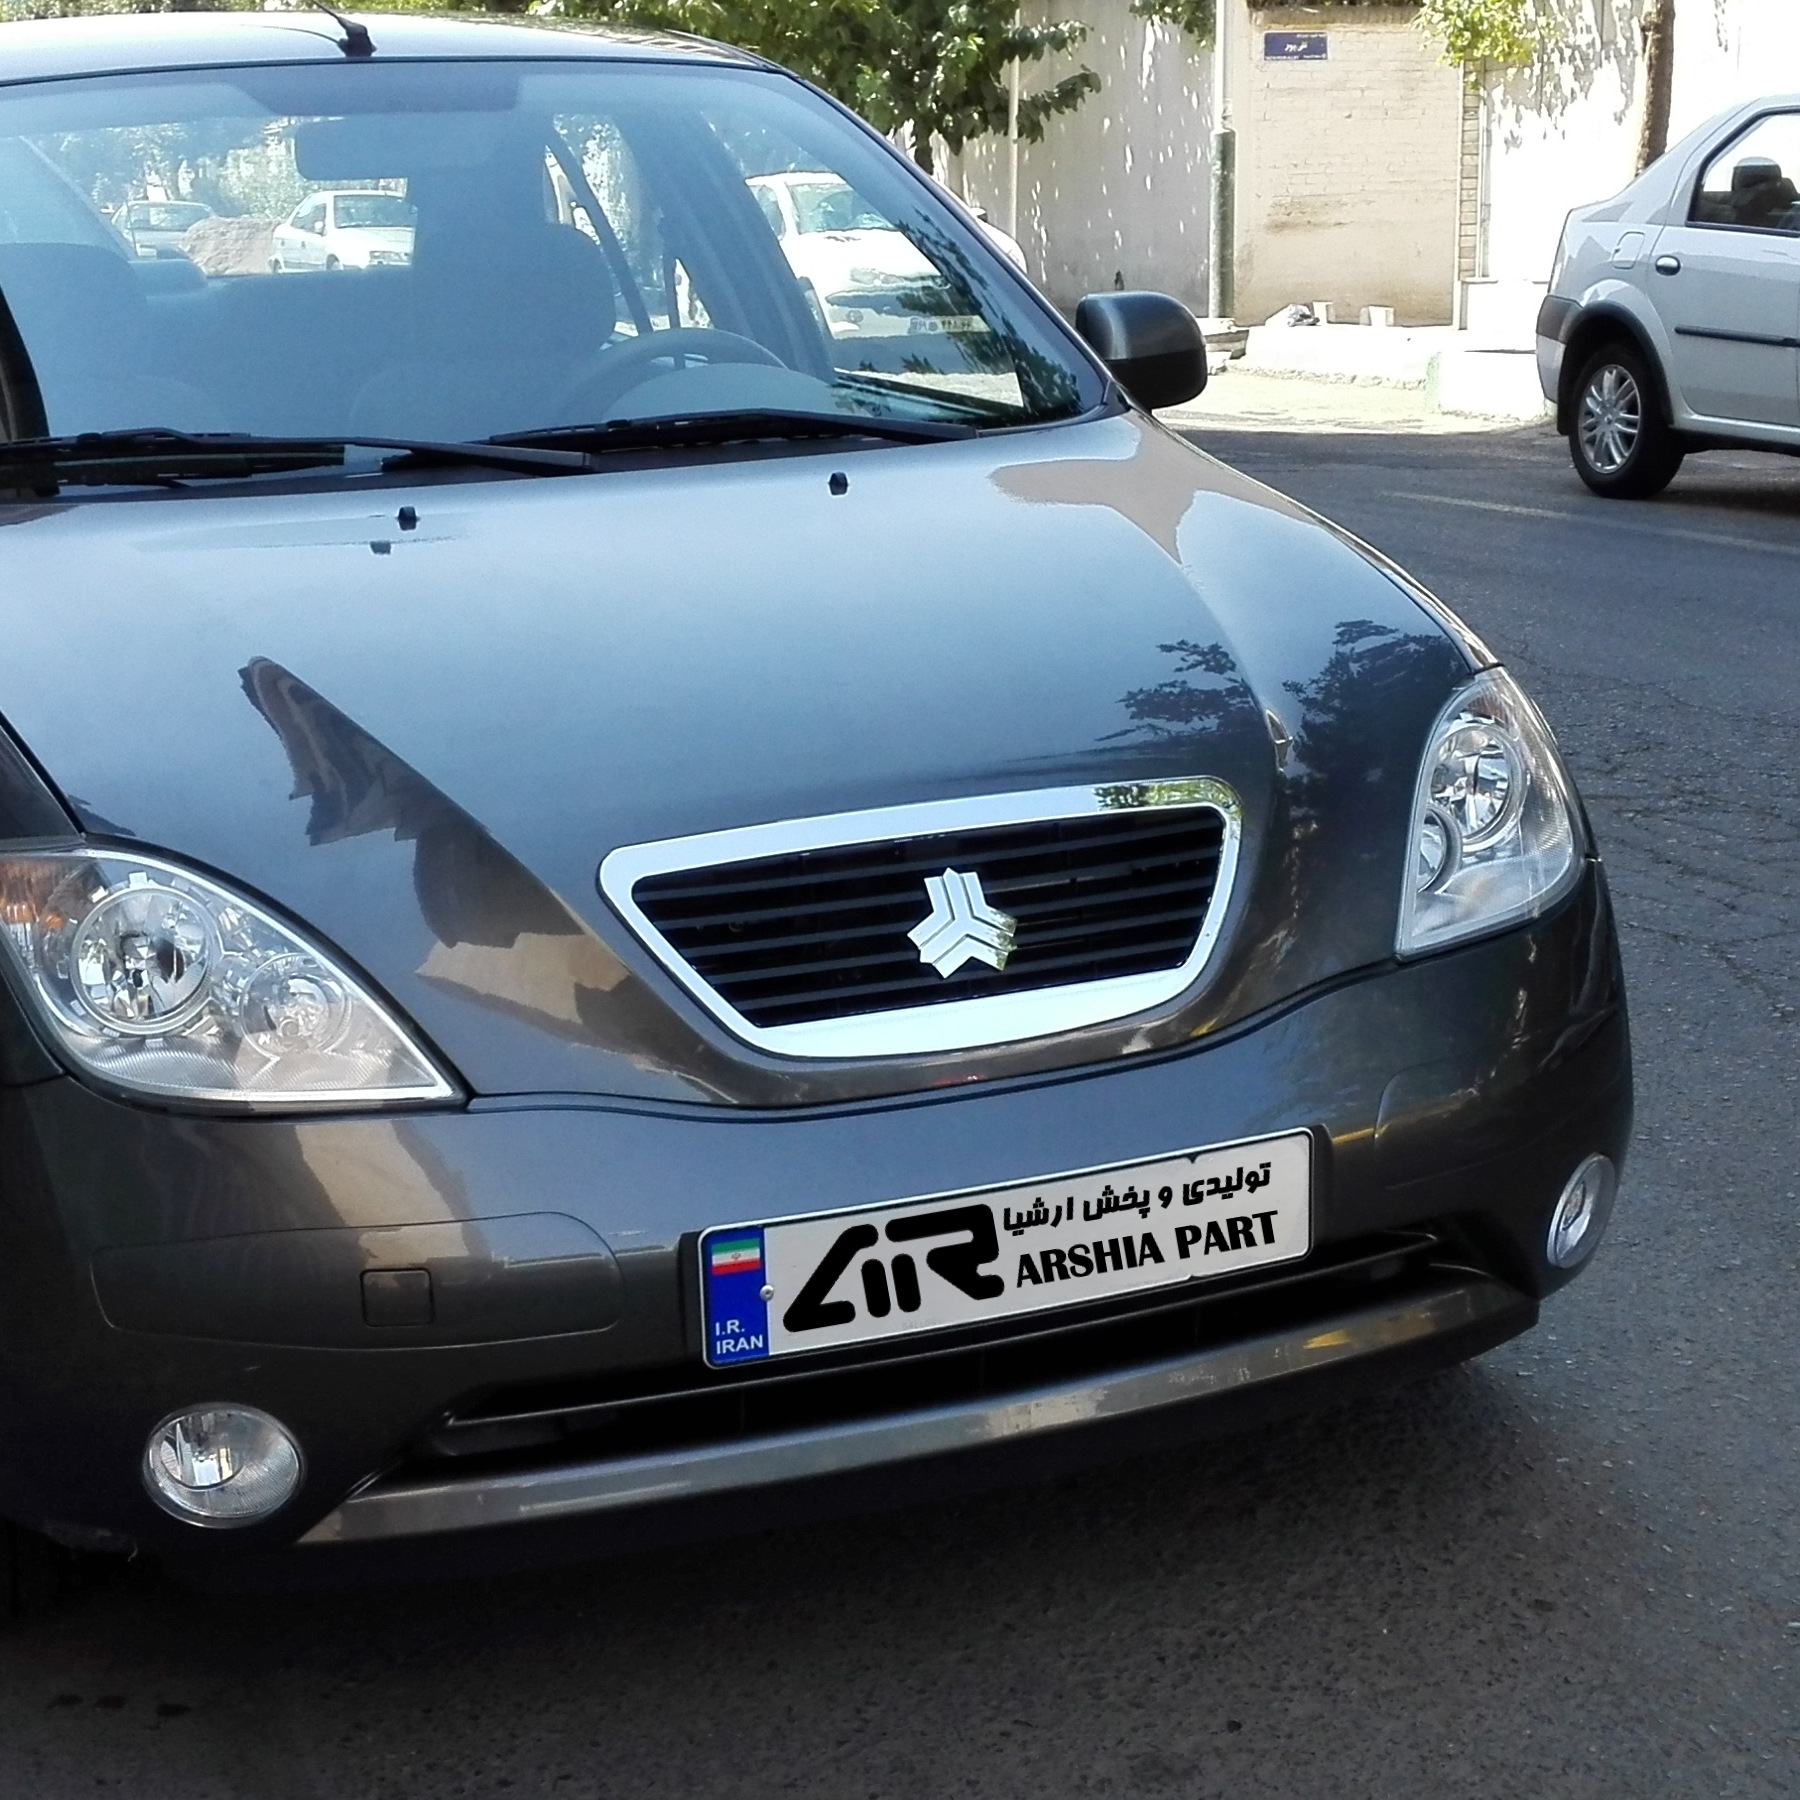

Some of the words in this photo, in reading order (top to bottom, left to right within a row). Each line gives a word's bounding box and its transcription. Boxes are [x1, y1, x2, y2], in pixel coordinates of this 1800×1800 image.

[1158, 1186, 1173, 1209] و
[1183, 1161, 1272, 1207] تولیدی
[1003, 1197, 1074, 1236] ارشیا
[1083, 1185, 1151, 1219] پخش
[1016, 1231, 1165, 1288] ARSHIA
[1174, 1210, 1278, 1260] PART
[715, 1319, 746, 1336] I.R.
[716, 1334, 763, 1355] IRAN
